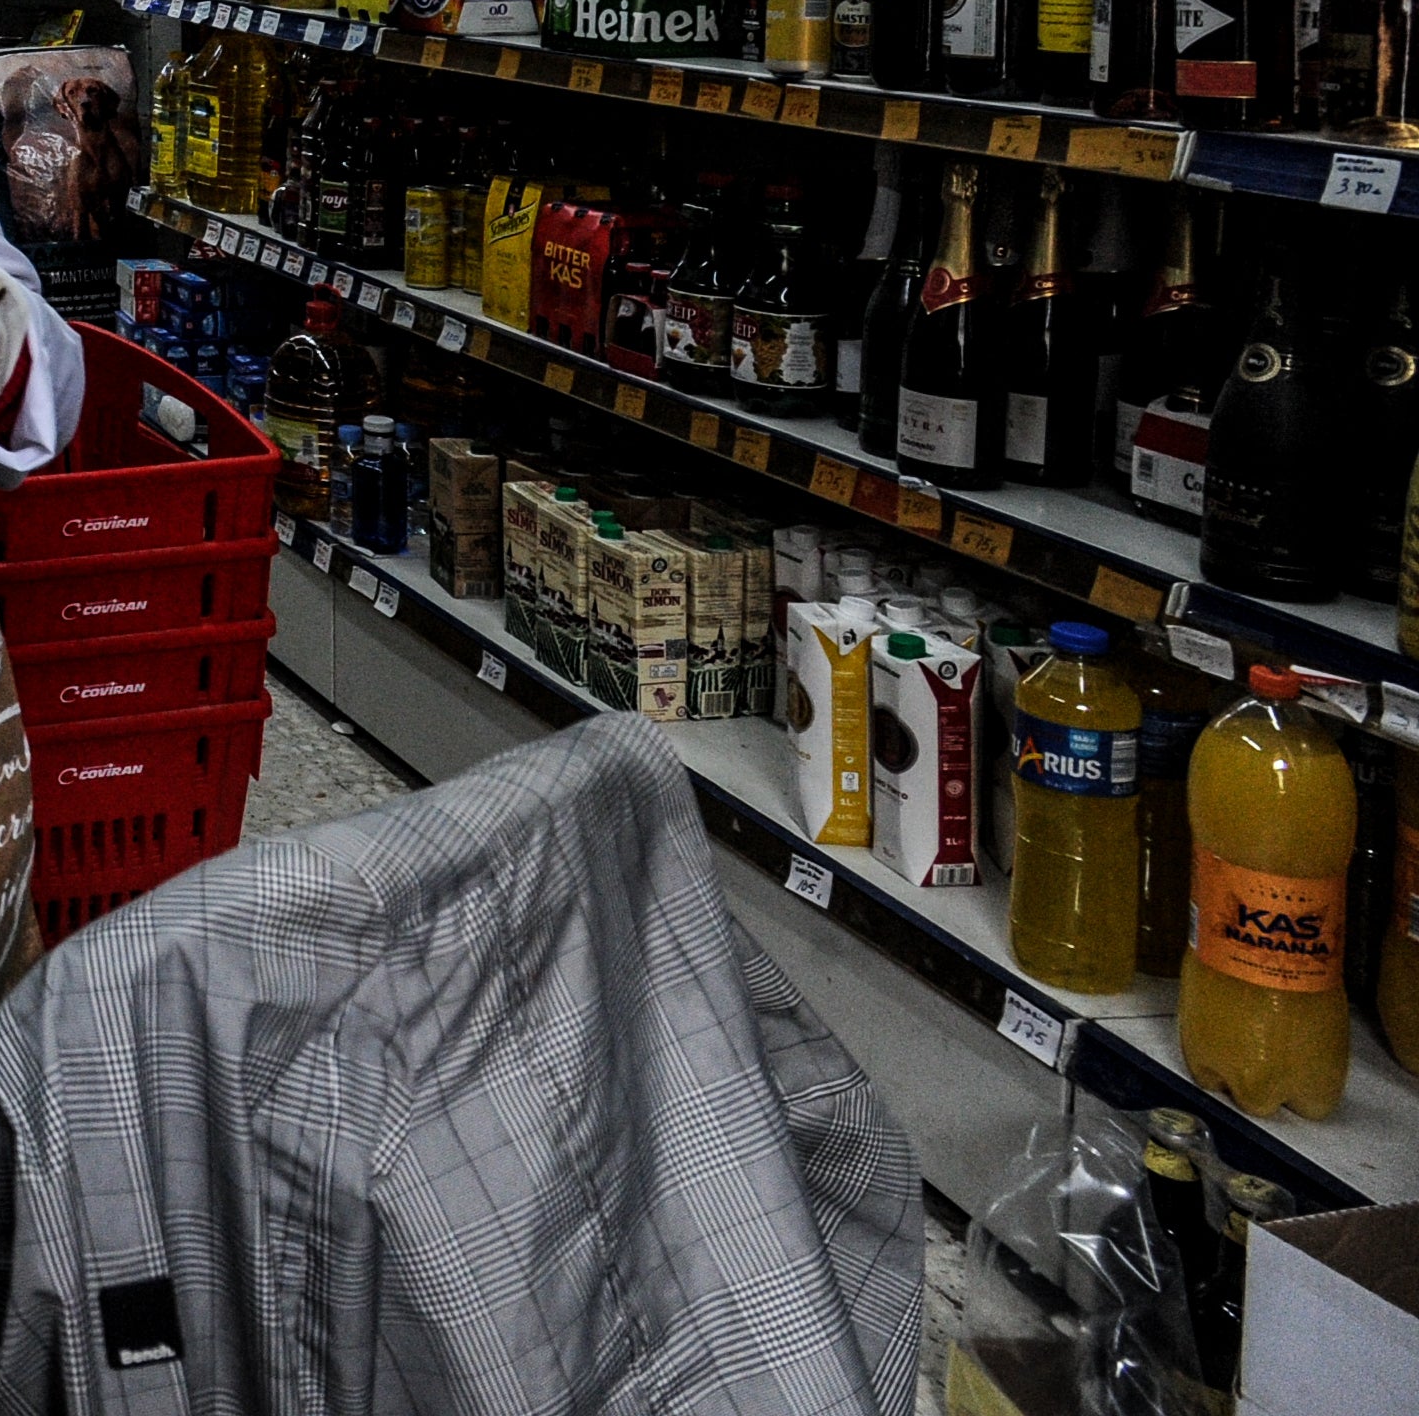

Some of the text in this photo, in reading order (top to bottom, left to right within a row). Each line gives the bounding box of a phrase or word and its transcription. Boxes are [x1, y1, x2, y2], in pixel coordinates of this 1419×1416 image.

[489, 211, 532, 241] Schweppes
[543, 240, 591, 271] BITTER
[548, 264, 584, 290] KAS
[83, 515, 149, 532] COVIRAN
[507, 508, 538, 535] SIMO
[592, 560, 634, 595] SIMON
[642, 595, 681, 608] SIMON
[650, 587, 671, 597] DON
[82, 599, 148, 616] COVIRAN
[80, 682, 146, 699] COVIRAN
[78, 763, 144, 781] COVIRAN
[1238, 902, 1322, 940] KAS
[1225, 925, 1331, 957] NARANJA
